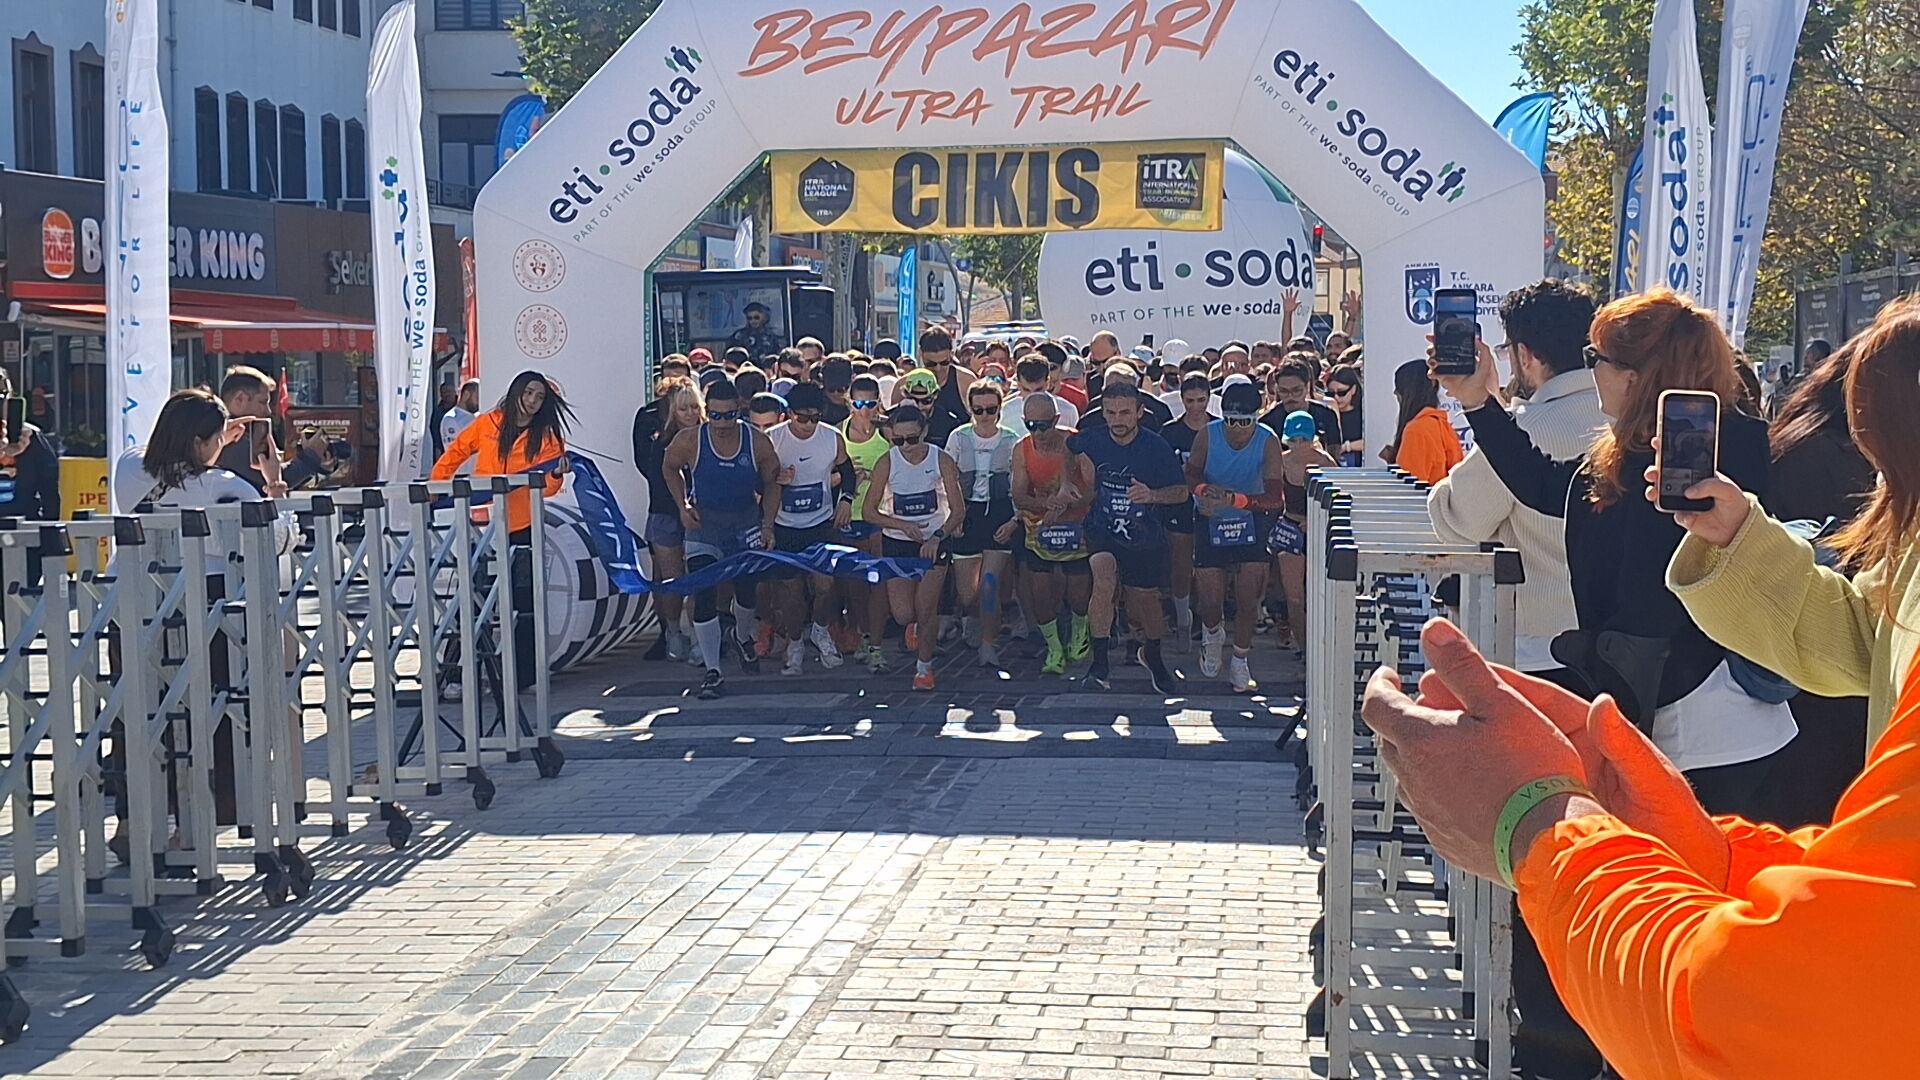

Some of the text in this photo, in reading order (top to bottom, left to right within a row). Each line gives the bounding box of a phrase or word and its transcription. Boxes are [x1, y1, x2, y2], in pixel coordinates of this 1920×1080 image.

[737, 0, 1236, 88] BEYPAZARI
[835, 82, 1153, 132] ULTRA TRAIL
[1273, 50, 1433, 202] eti soda
[130, 101, 143, 199] LIFE
[550, 76, 702, 223] eti soda
[573, 217, 600, 242] PART
[600, 204, 615, 218] OF
[614, 183, 636, 204] THE
[683, 99, 717, 135] GROUP
[1254, 74, 1280, 101] PART
[1281, 100, 1296, 115] OF
[1298, 113, 1319, 136] THE
[1372, 184, 1410, 217] GROUP
[1696, 126, 1706, 194] GROUP
[44, 245, 74, 263] KING
[131, 237, 141, 327] FOR
[200, 227, 266, 281] KING
[1085, 238, 1313, 297] eti soda
[1450, 271, 1470, 281] T.C.
[1091, 310, 1126, 325] PART
[1134, 307, 1155, 321] OF
[1164, 305, 1195, 319] THE
[412, 357, 422, 387] THE
[411, 400, 420, 420] OF
[409, 428, 419, 469] PART
